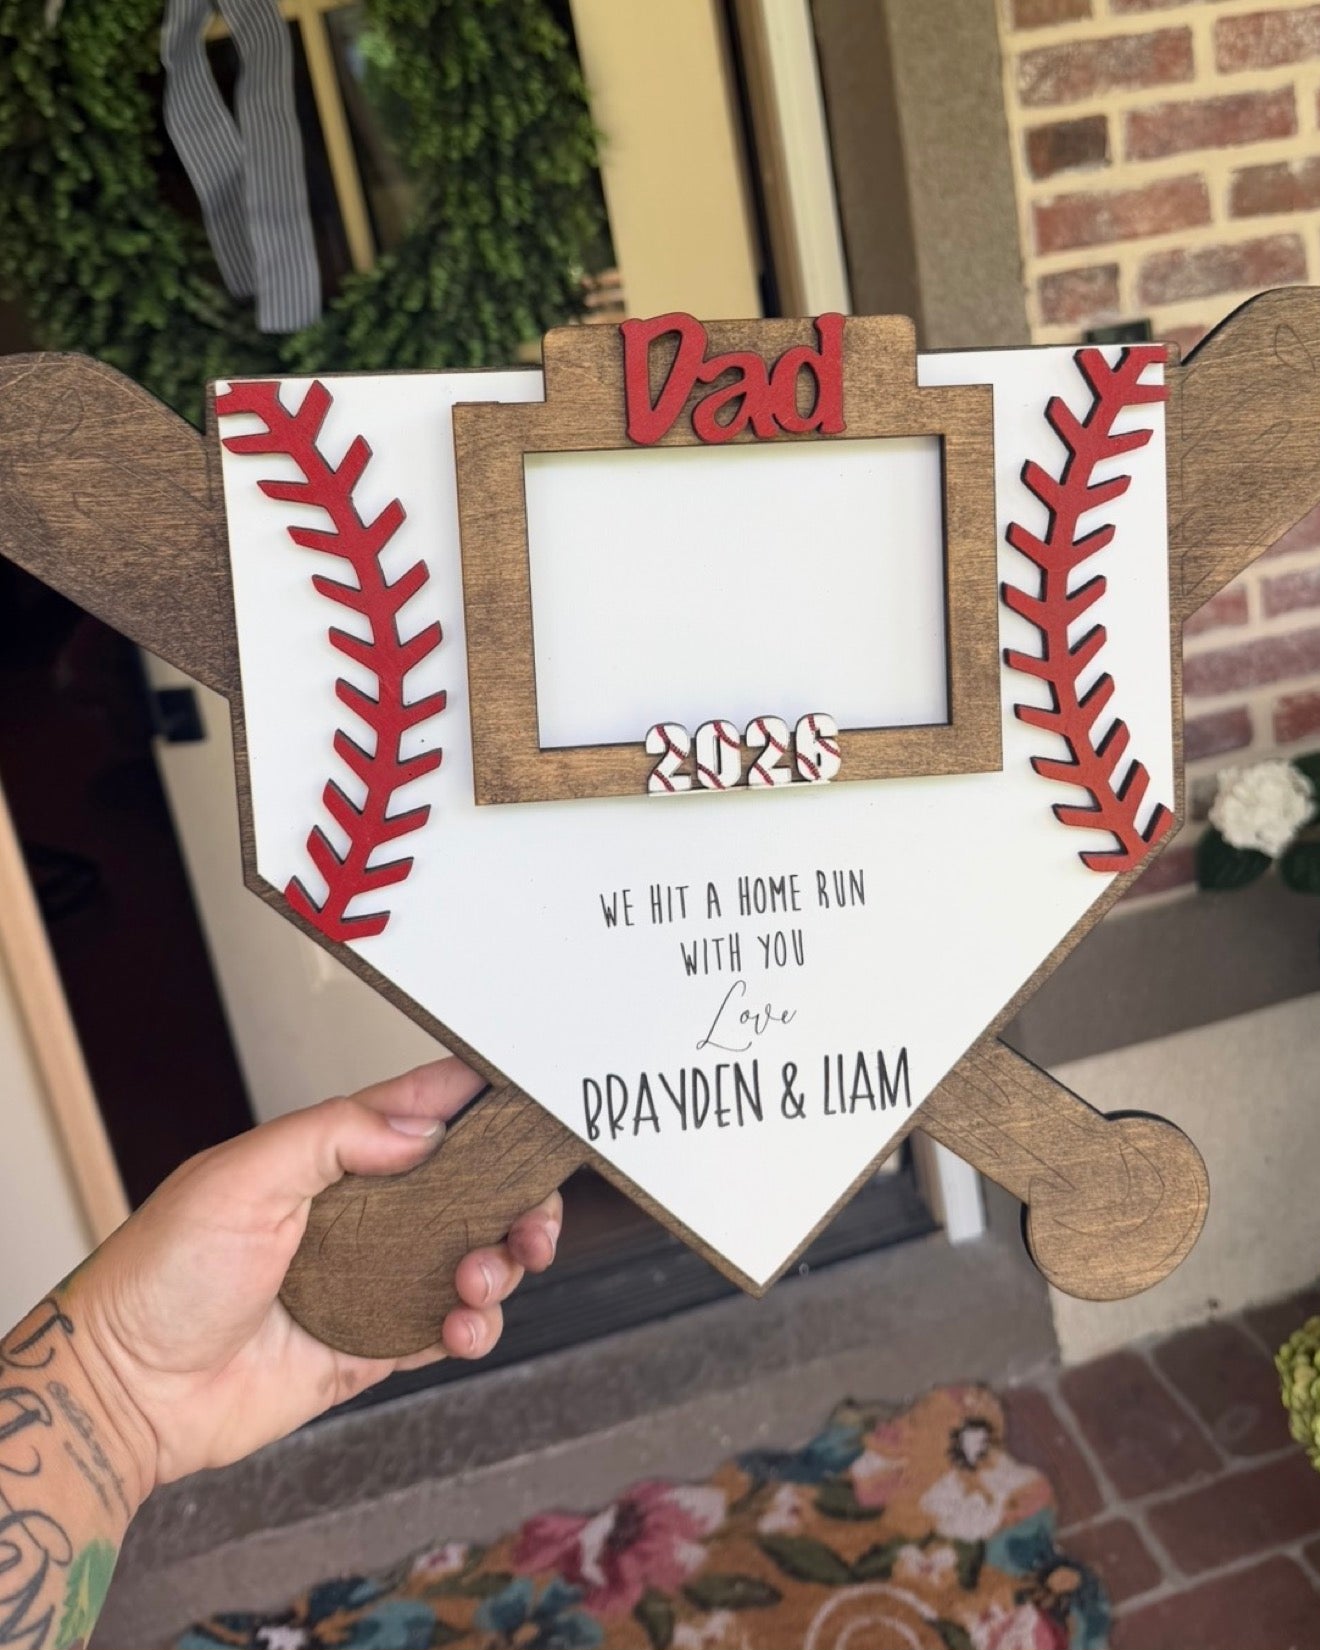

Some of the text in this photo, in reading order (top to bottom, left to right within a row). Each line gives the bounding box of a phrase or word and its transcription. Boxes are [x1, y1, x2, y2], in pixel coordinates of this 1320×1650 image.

[620, 313, 846, 446] Dad
[645, 712, 843, 793] 2026
[599, 869, 866, 929] WE HIT A HOME RUN
[680, 929, 805, 977] WITH YOU
[696, 980, 797, 1053] Love
[582, 1046, 912, 1142] BRAYDEN & LIAM
